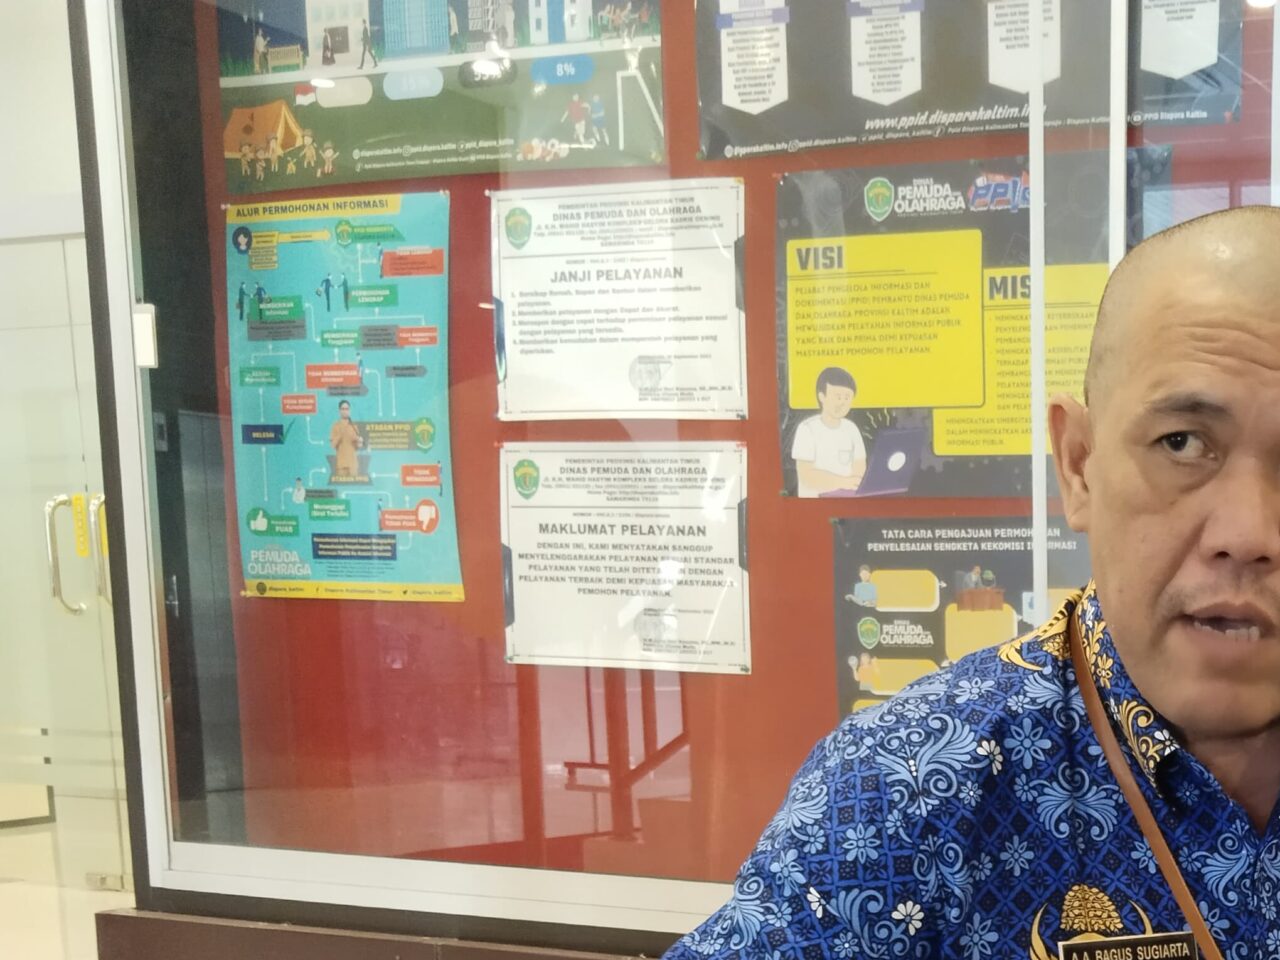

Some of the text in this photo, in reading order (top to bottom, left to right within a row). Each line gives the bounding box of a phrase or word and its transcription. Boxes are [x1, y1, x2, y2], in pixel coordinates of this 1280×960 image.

[556, 62, 575, 77] 8%
[865, 103, 1047, 132] www.ppid.disporakaltim.i
[898, 184, 951, 199] PEMUDA
[236, 199, 389, 217] ALUR PERMOHONAN INFORMASI
[894, 196, 966, 213] OLAHRAGA
[553, 205, 702, 222] DINAS PEMUDA DAN OLAHRAGA
[796, 245, 843, 270] VISI
[550, 266, 684, 284] JANJI PELAYANAN
[988, 274, 1031, 301] MIS
[560, 466, 708, 476] DINAS PEMUDA DAN OLAHRAGA
[538, 522, 708, 538] MAKLUMAT PELAYANAN
[881, 527, 1061, 539] TATA CARA PENGAJUAN PERMOHAN
[537, 542, 571, 550] DENGAN
[589, 542, 609, 550] KAMI
[611, 543, 669, 552] MENYATAKAN
[867, 542, 932, 552] PENYELESAIAN
[934, 541, 979, 552] SENGKETA
[981, 541, 1024, 551] KEKOMISI
[250, 549, 300, 562] PEMUDA
[518, 552, 606, 562] MENYELENGGARAKAN
[608, 554, 658, 563] PELAYANAN
[694, 556, 735, 565] STANDAR
[247, 561, 312, 576] OLAHRAGA
[528, 563, 576, 573] PELAYANAN
[578, 565, 602, 573] YANG
[603, 565, 630, 574] TELAH
[688, 567, 724, 577] DENGAN
[519, 574, 566, 583] PELAYANAN
[568, 575, 603, 584] TERBAIK
[605, 576, 626, 585] DEMI
[577, 587, 618, 596] PEMOHON
[882, 624, 923, 636] PEMUDA
[880, 633, 934, 645] OLAHRAGA
[1137, 942, 1190, 960] SUGIARTA
